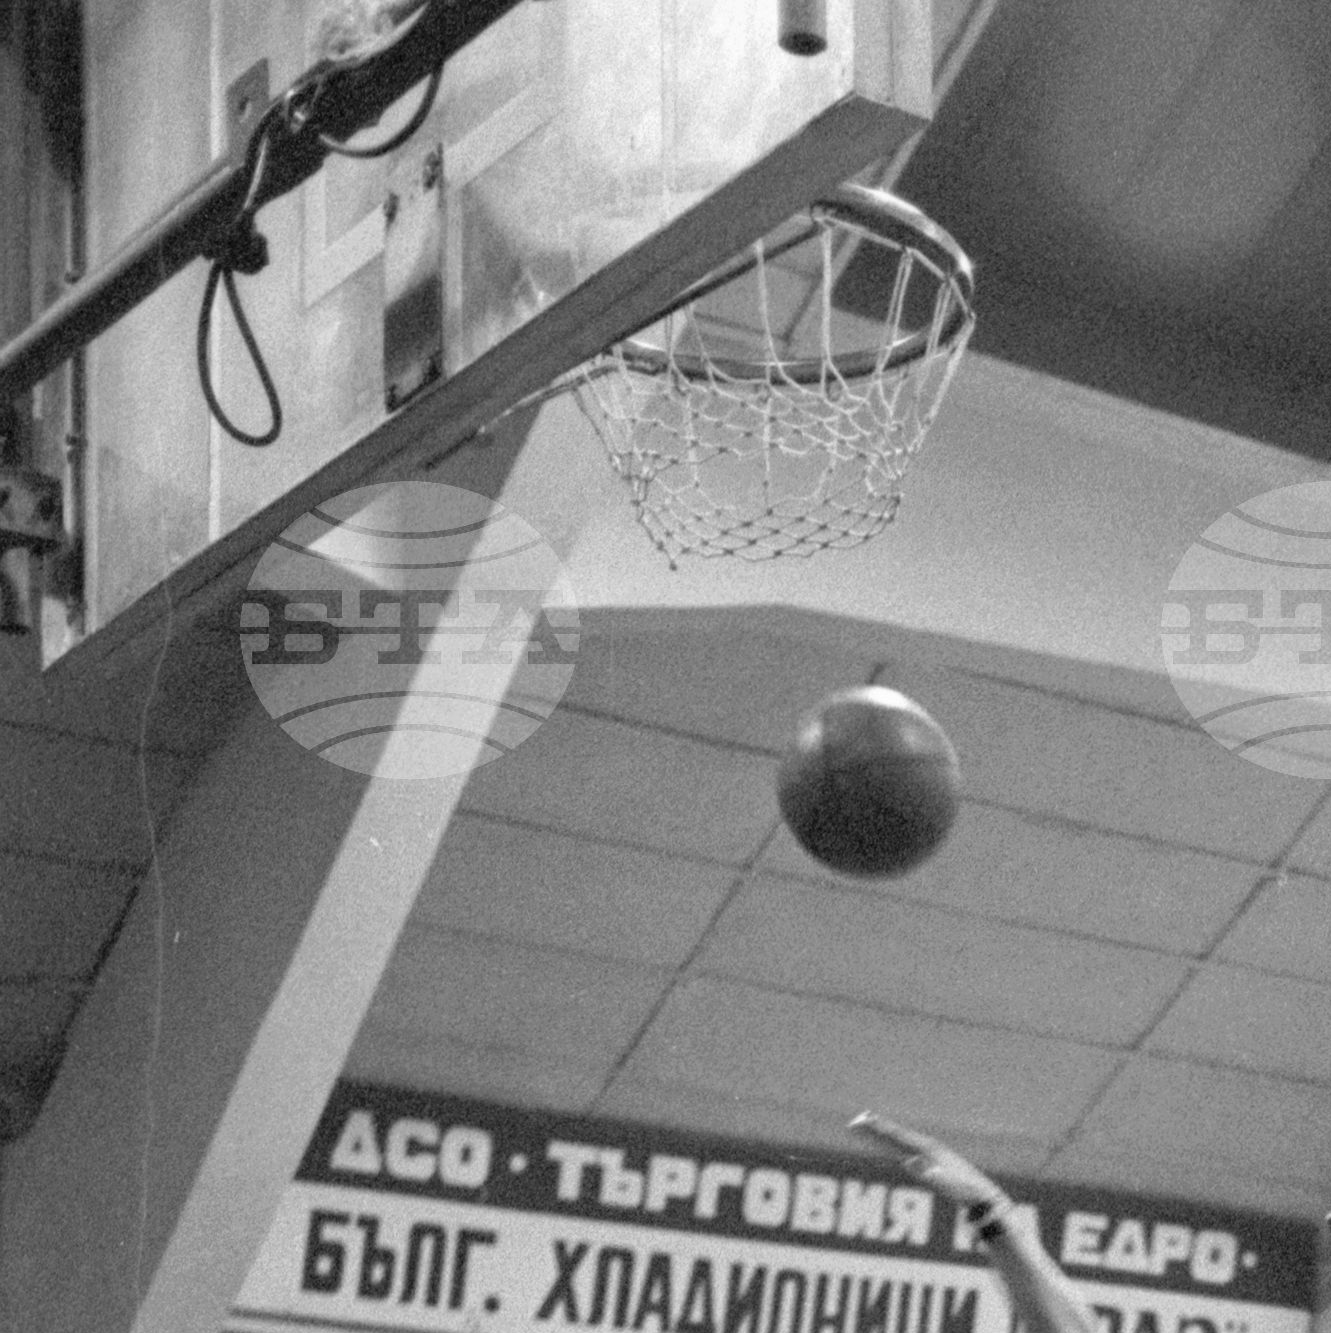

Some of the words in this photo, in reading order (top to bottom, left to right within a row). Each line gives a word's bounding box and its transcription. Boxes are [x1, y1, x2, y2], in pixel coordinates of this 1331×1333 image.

[330, 1110, 493, 1188] ДСО
[545, 1139, 934, 1247] ТЪРГОВИЯ
[301, 1208, 500, 1313] БЪЛГ.
